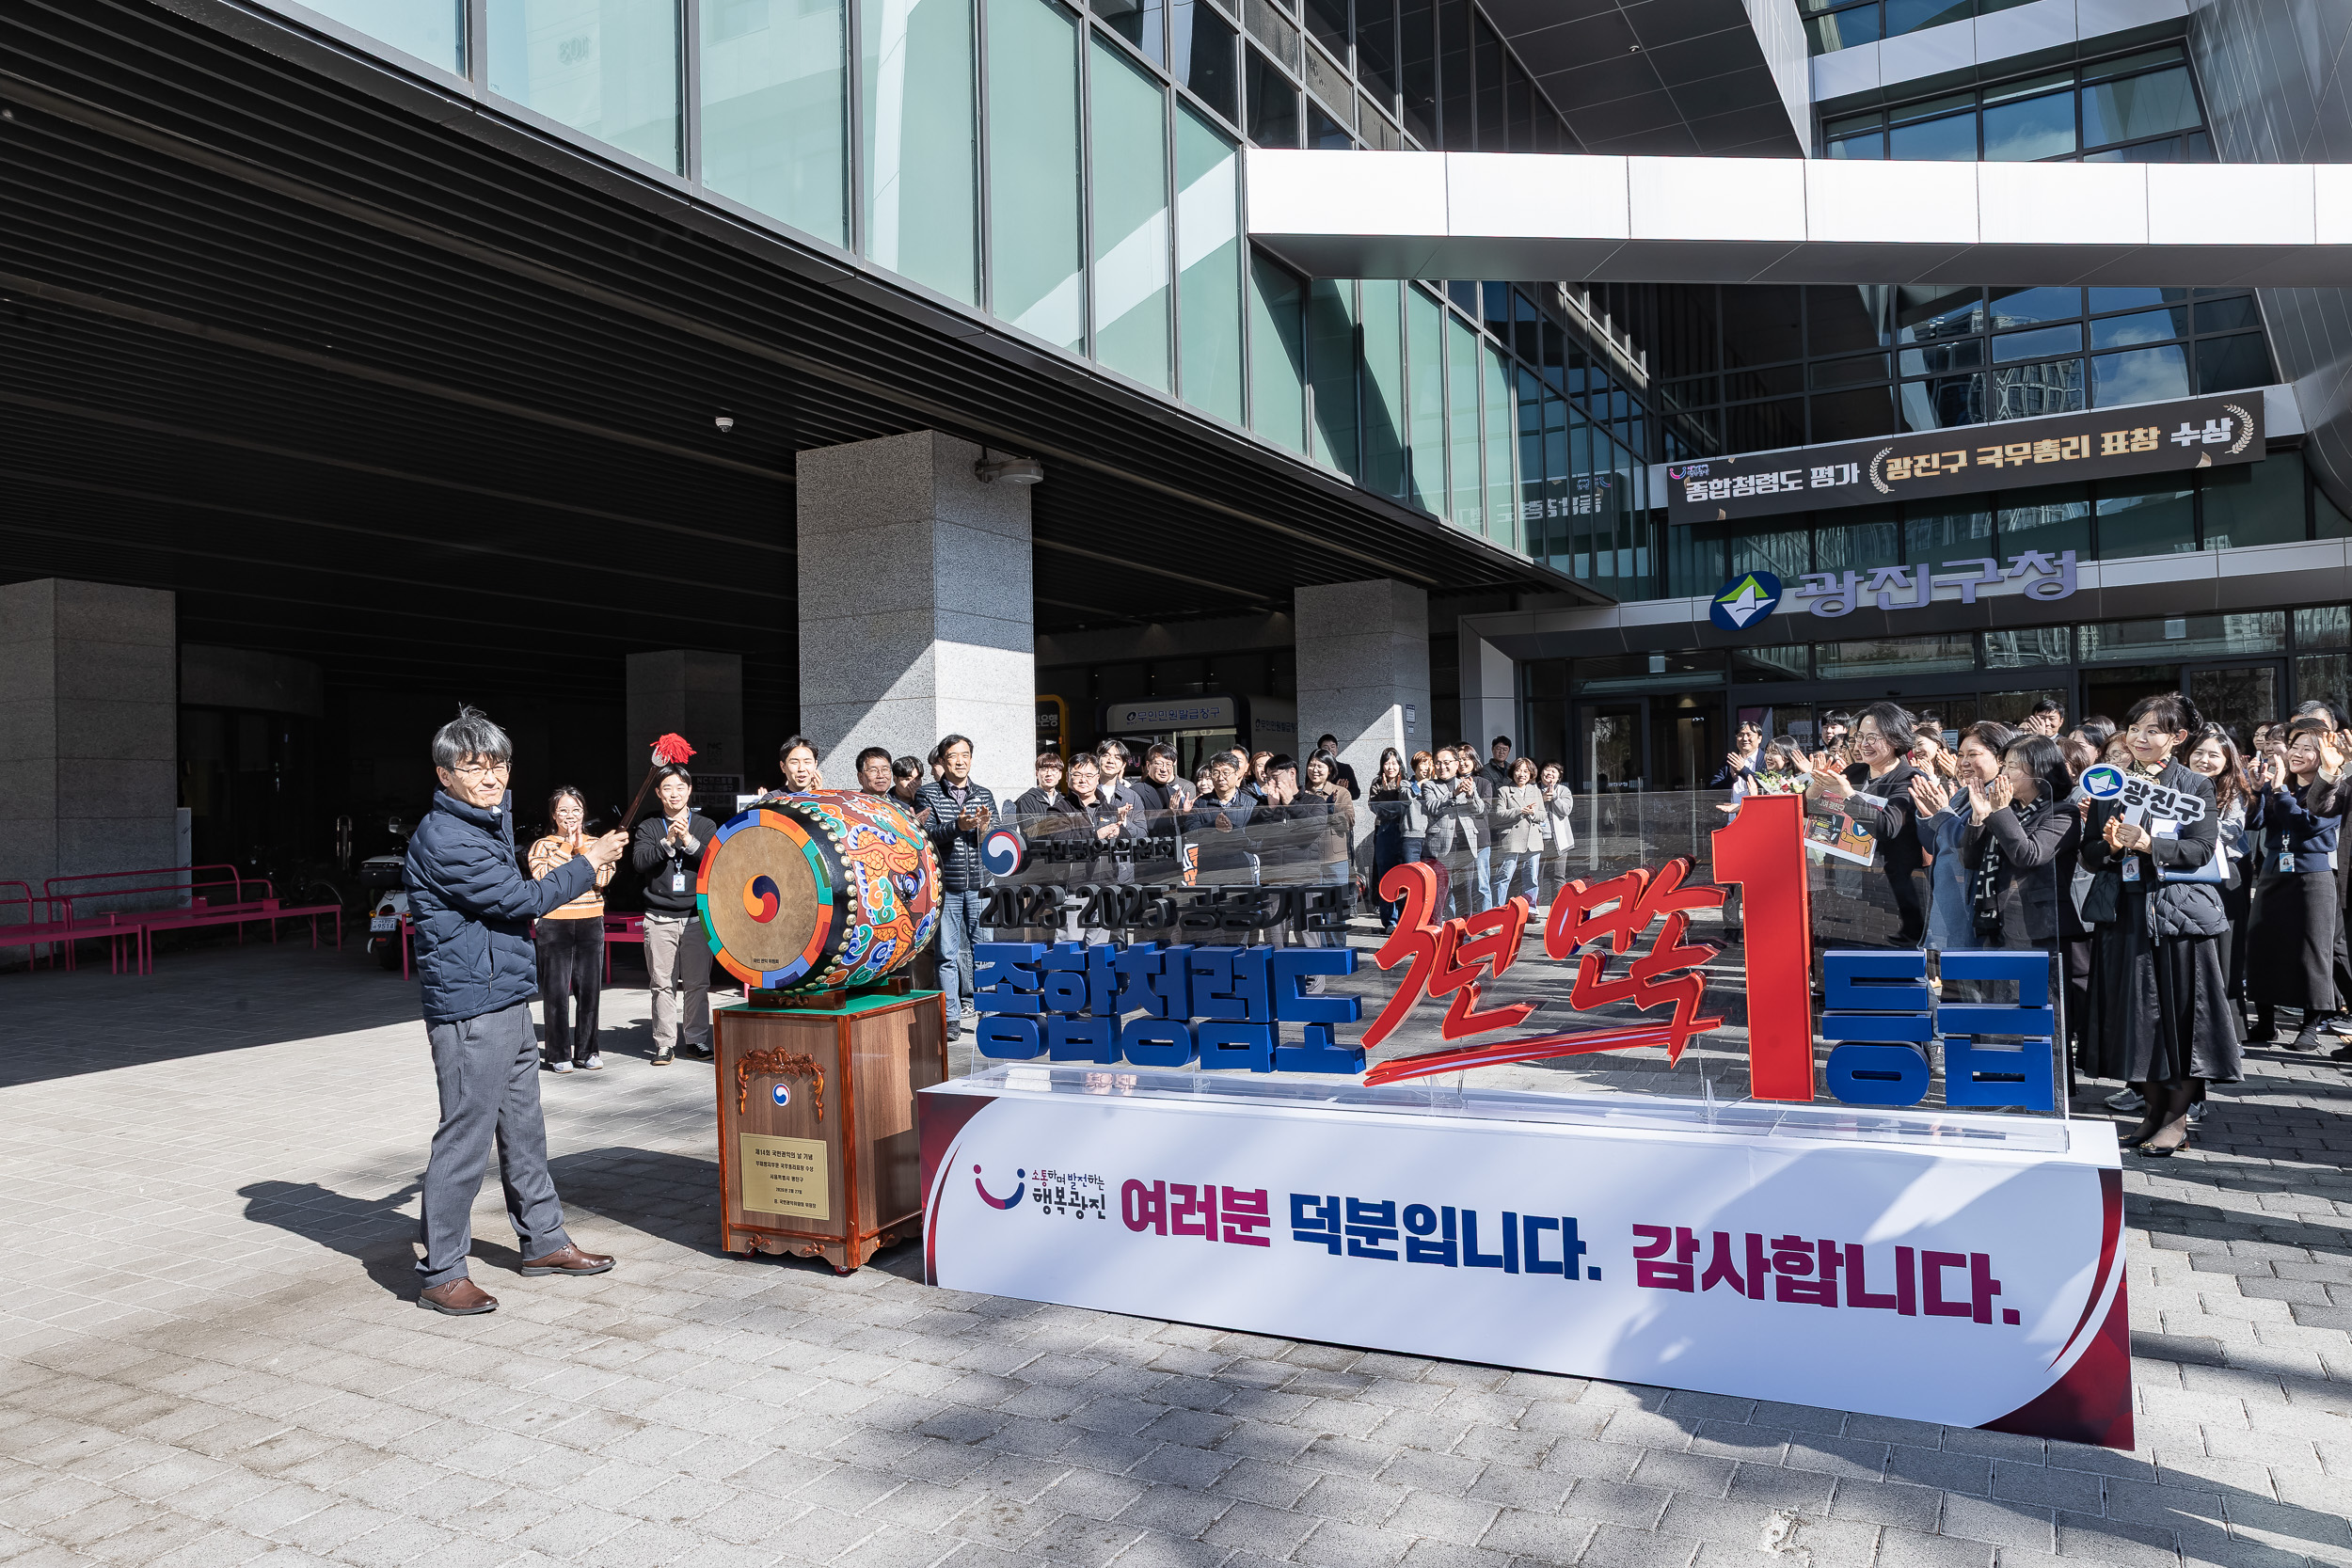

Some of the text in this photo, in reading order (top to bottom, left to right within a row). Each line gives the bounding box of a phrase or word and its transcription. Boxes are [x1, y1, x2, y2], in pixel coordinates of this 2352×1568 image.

[1686, 468, 1804, 503] 종합청렴도
[1810, 462, 1861, 488] 평가
[1886, 449, 1968, 481] 광진구
[1976, 434, 2090, 468] 국무총리
[2100, 425, 2161, 457] 표창
[2170, 417, 2234, 447] 수상
[1794, 549, 2078, 618] 광진구청
[1036, 714, 1058, 727] 은행
[1137, 707, 1220, 722] 무인민원발급창구
[1261, 719, 1298, 734] 무인민원발급창
[2123, 780, 2201, 822] 광진구
[977, 883, 1353, 932] 2023-2025 공공기관
[974, 940, 1367, 1074] 종합청렴도
[1361, 861, 1537, 1051] 3년
[1545, 855, 1727, 1069] 연속
[1031, 1169, 1104, 1191] 소통하며 발전하는
[1032, 1186, 1106, 1220] 행복광진
[1120, 1178, 2022, 1326] 여러분 덕분입니다. 감사합니다.
